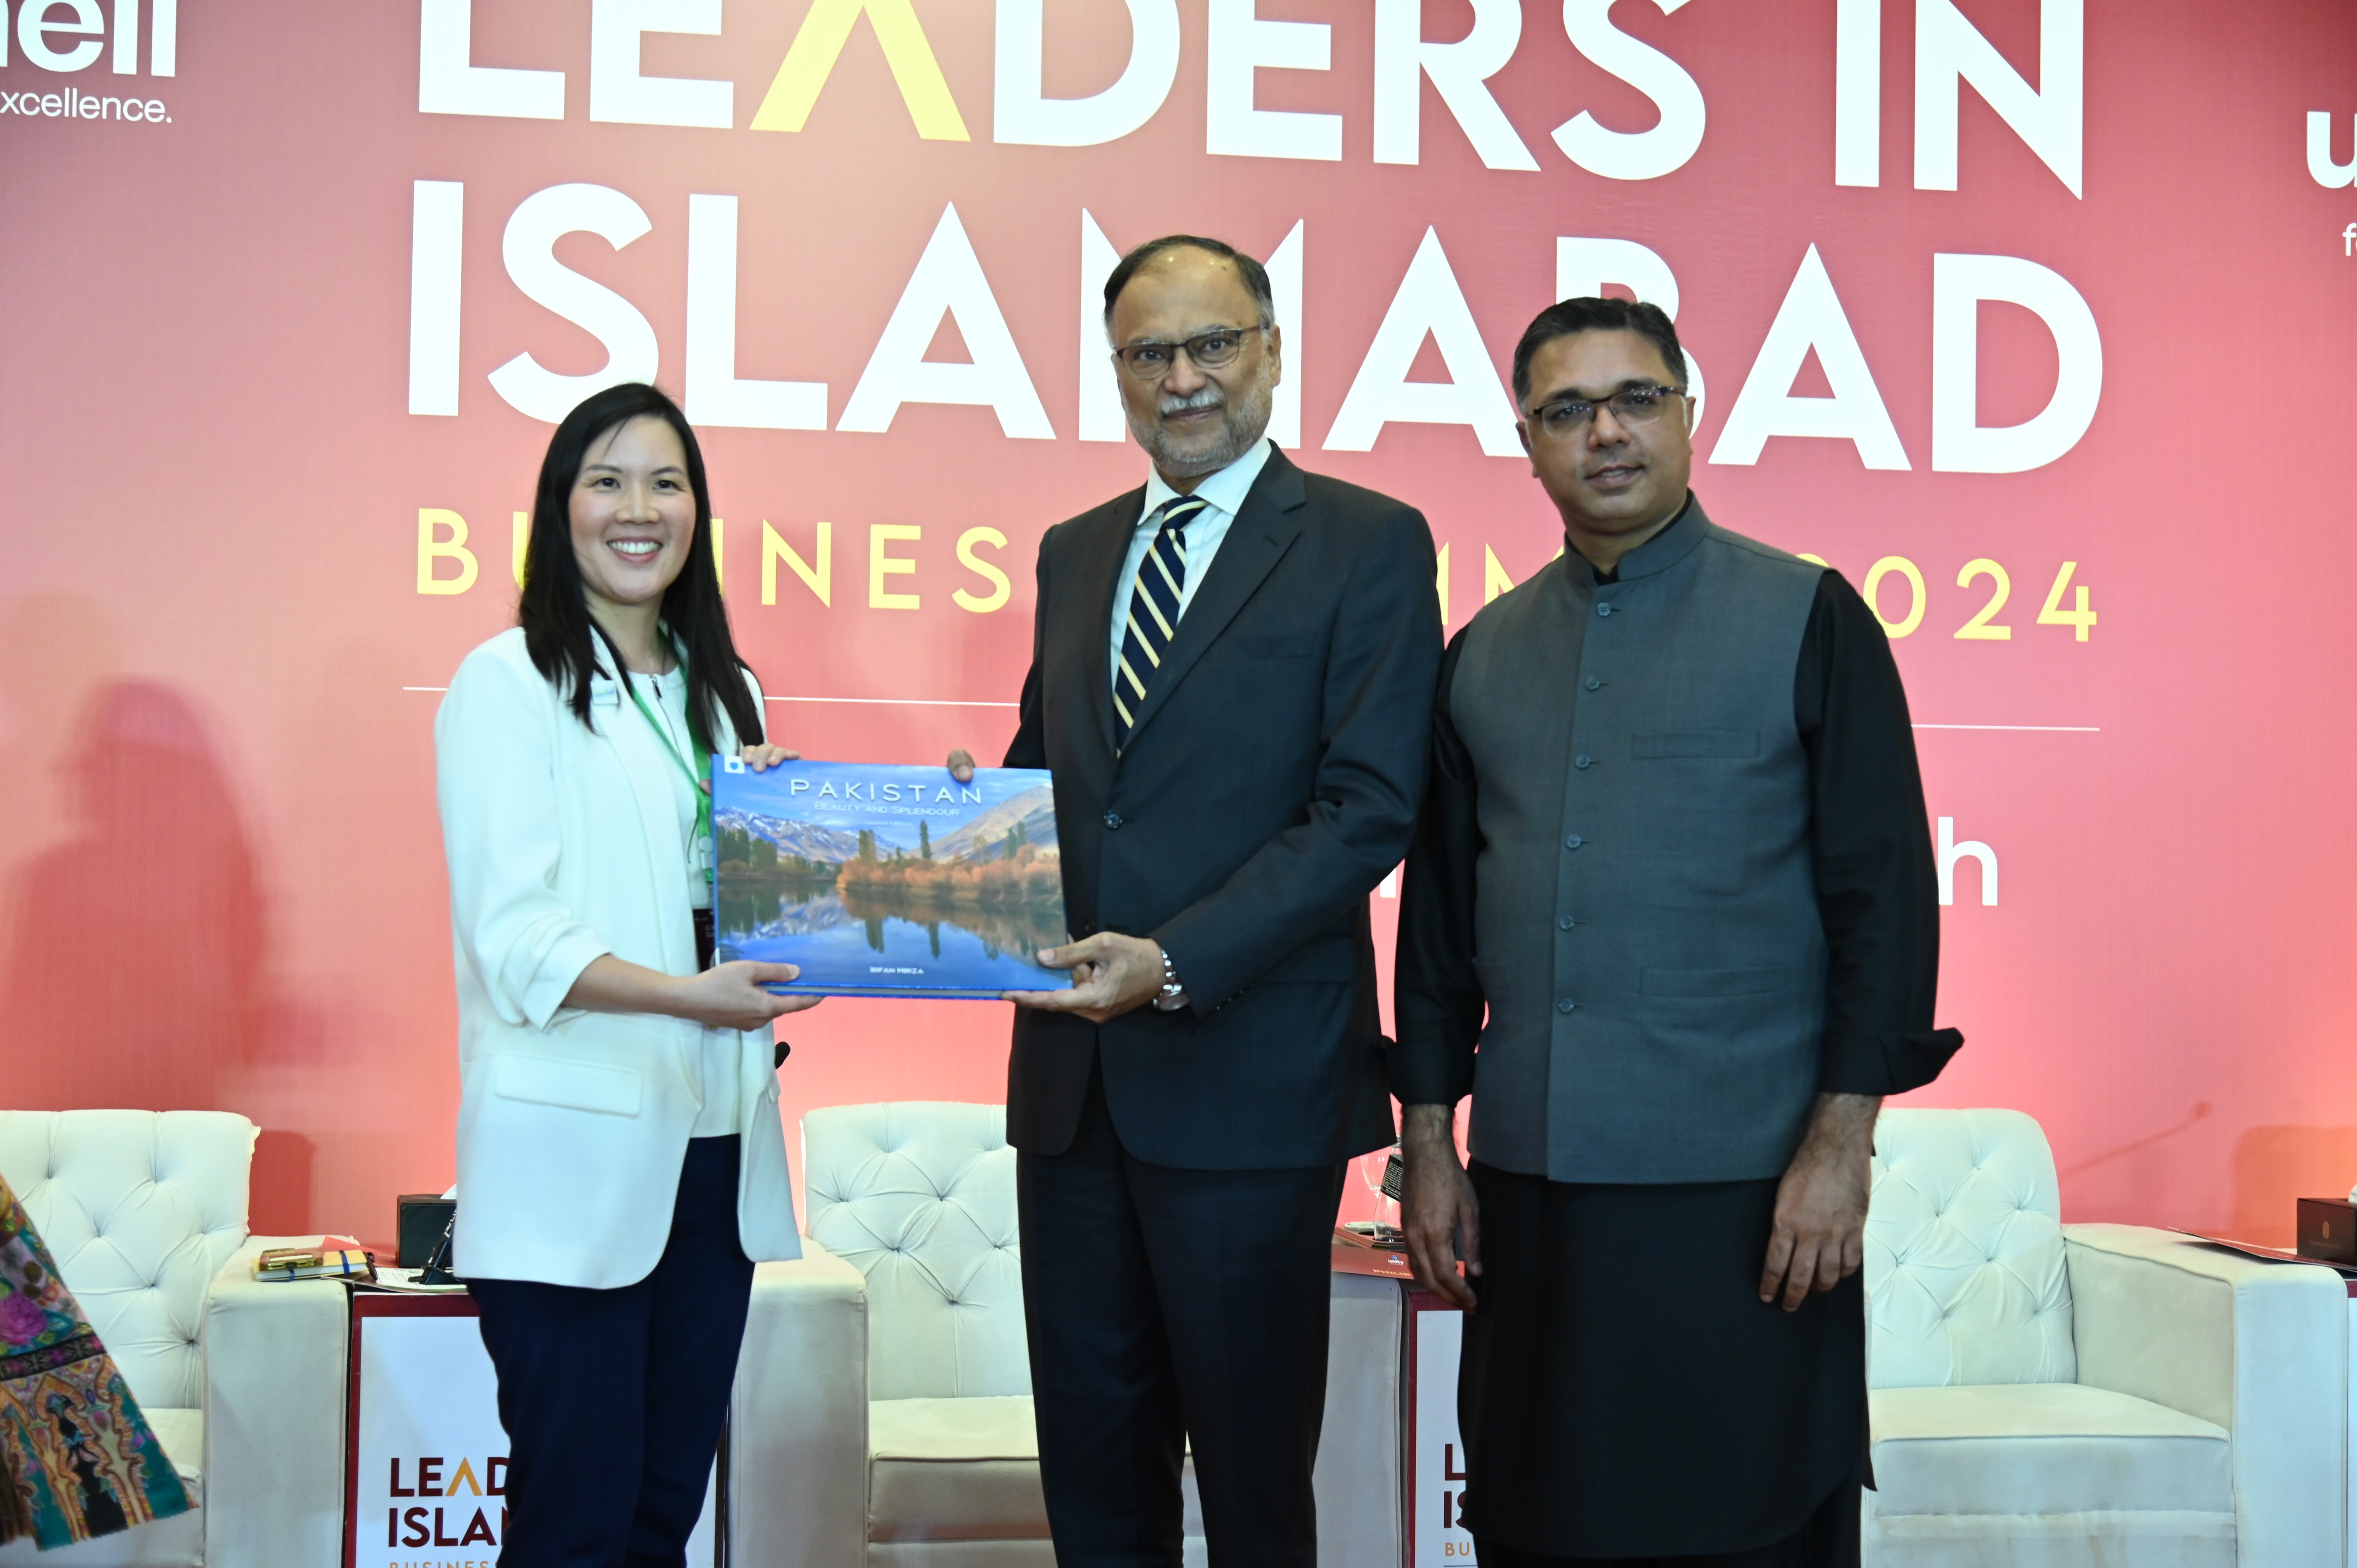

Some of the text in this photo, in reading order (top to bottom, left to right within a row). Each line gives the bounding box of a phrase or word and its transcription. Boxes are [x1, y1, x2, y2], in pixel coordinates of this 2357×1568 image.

[0, 0, 177, 77] ell
[1836, 0, 2083, 200] IN
[1796, 553, 2097, 642] 024
[790, 779, 982, 804] PAKISTAN
[815, 802, 959, 816] BEAUTY AND SPLENDOUR
[389, 1506, 510, 1548] ISLA
